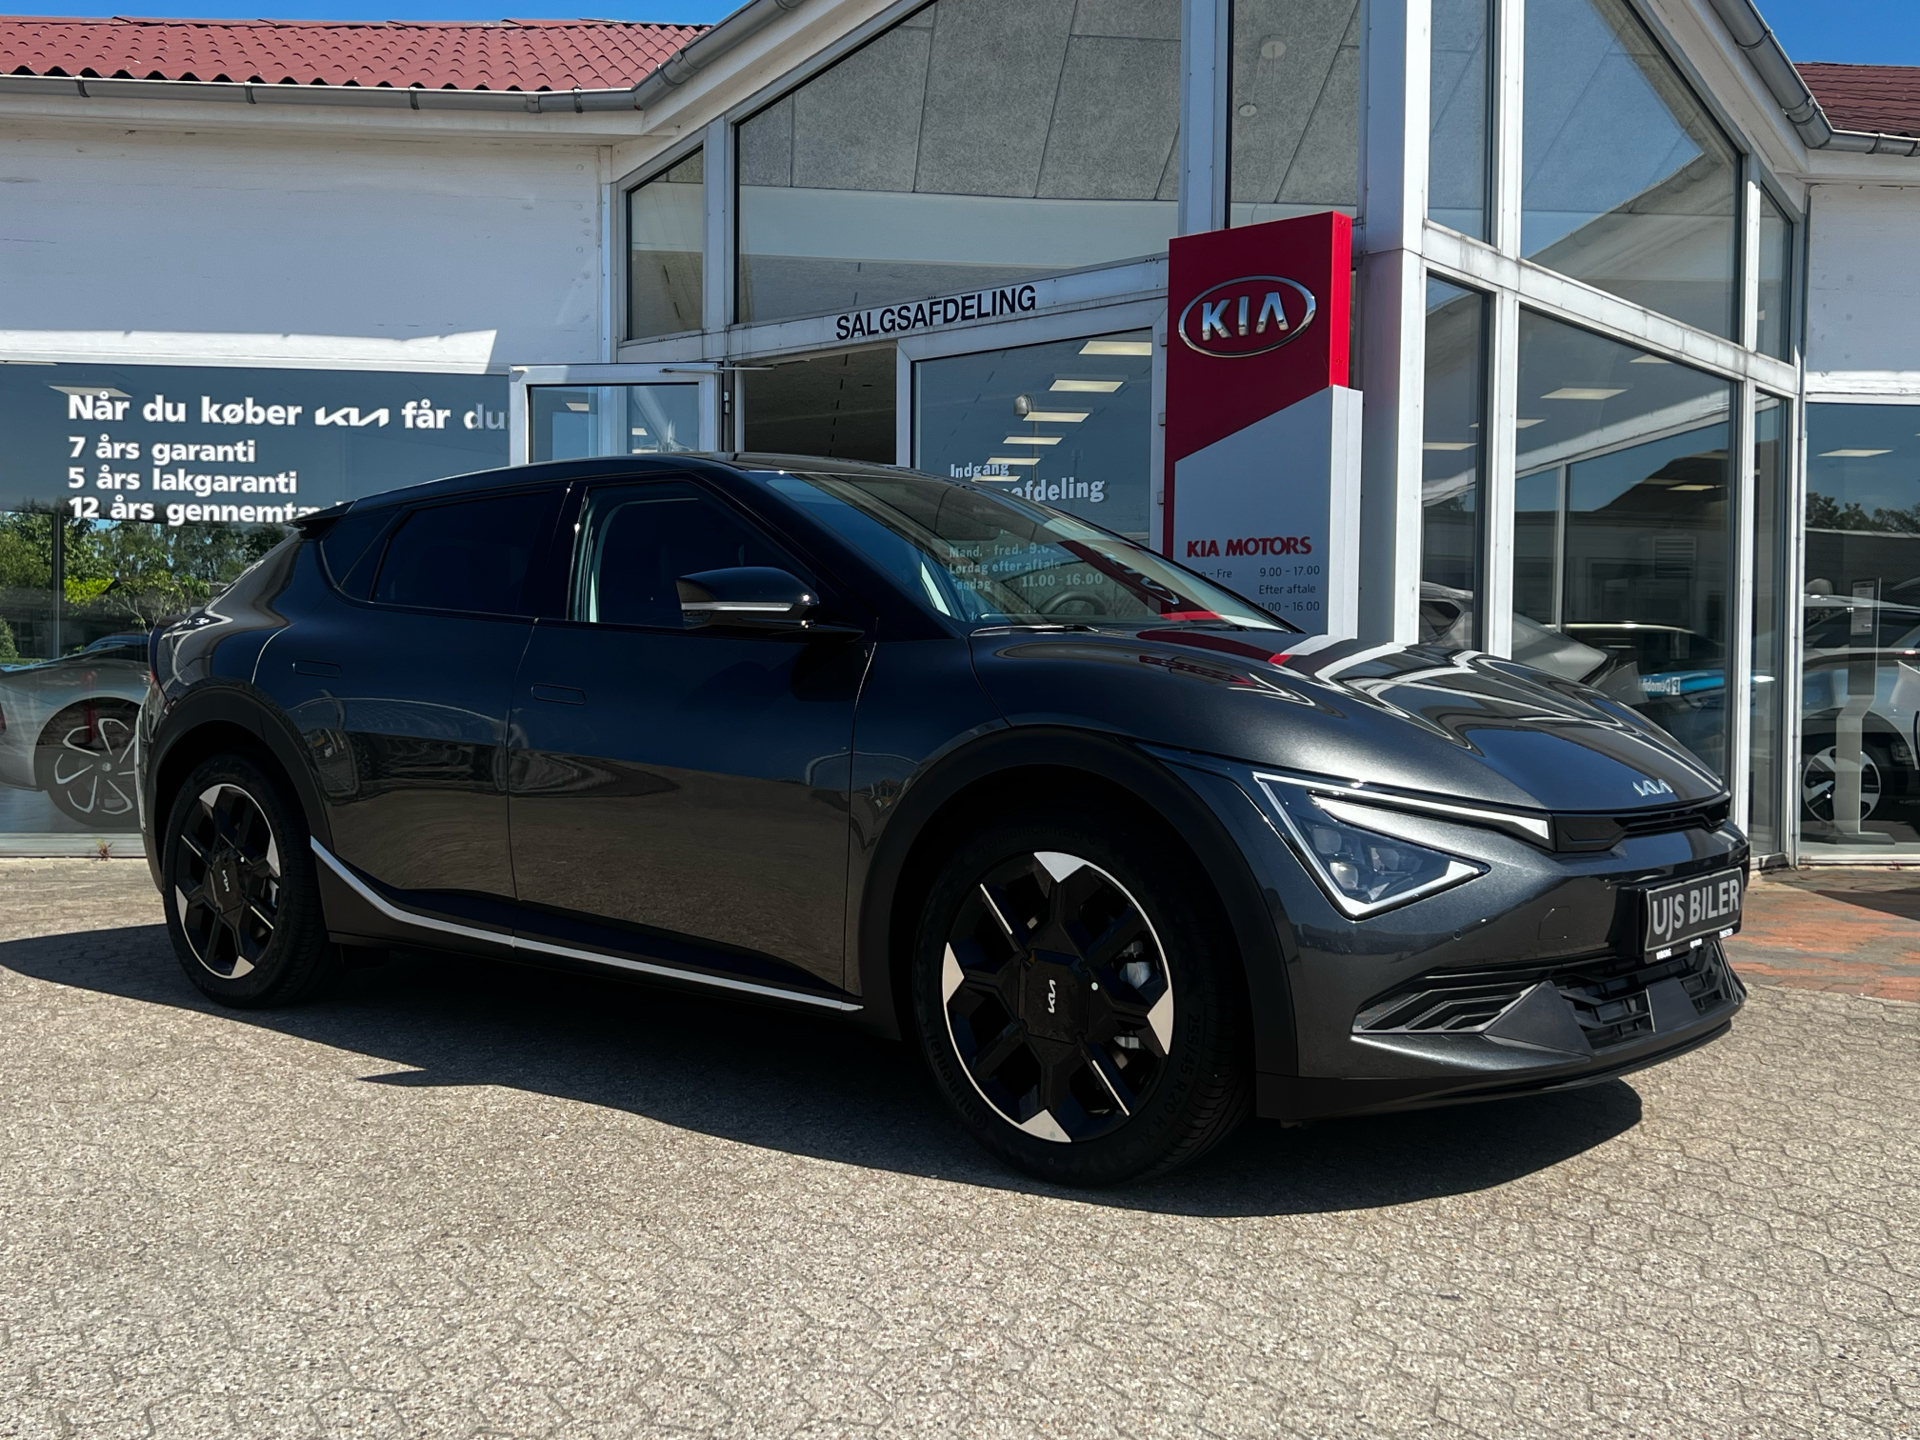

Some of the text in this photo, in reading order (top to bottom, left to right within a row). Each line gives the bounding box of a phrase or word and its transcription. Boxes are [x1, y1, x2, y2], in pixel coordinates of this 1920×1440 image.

[836, 285, 1036, 340] SALGSAFDELING
[1201, 291, 1289, 341] KIA
[68, 391, 130, 421] Når
[143, 394, 186, 423] du
[201, 395, 303, 425] køber
[401, 398, 452, 430] får
[68, 433, 256, 465] 7 års garanti
[68, 464, 297, 497] 5 års lakgaranti
[950, 462, 1009, 479] Indgang
[1002, 477, 1105, 503] afdeling
[68, 497, 99, 519] 12
[110, 494, 155, 520] års
[994, 543, 1023, 556] fred.
[1187, 536, 1312, 557] KIA MOTORS
[949, 562, 988, 575] Lørdag
[992, 560, 1022, 573] efter
[1217, 568, 1232, 579] Fre
[1259, 567, 1282, 577] 9.00
[1293, 565, 1320, 576] 17.00
[1022, 574, 1056, 588] 11.00
[1066, 572, 1104, 586] 16.00
[1259, 583, 1316, 595] Efter aftale
[1293, 601, 1320, 612] 16.00
[1652, 878, 1740, 941] UJS BILER
